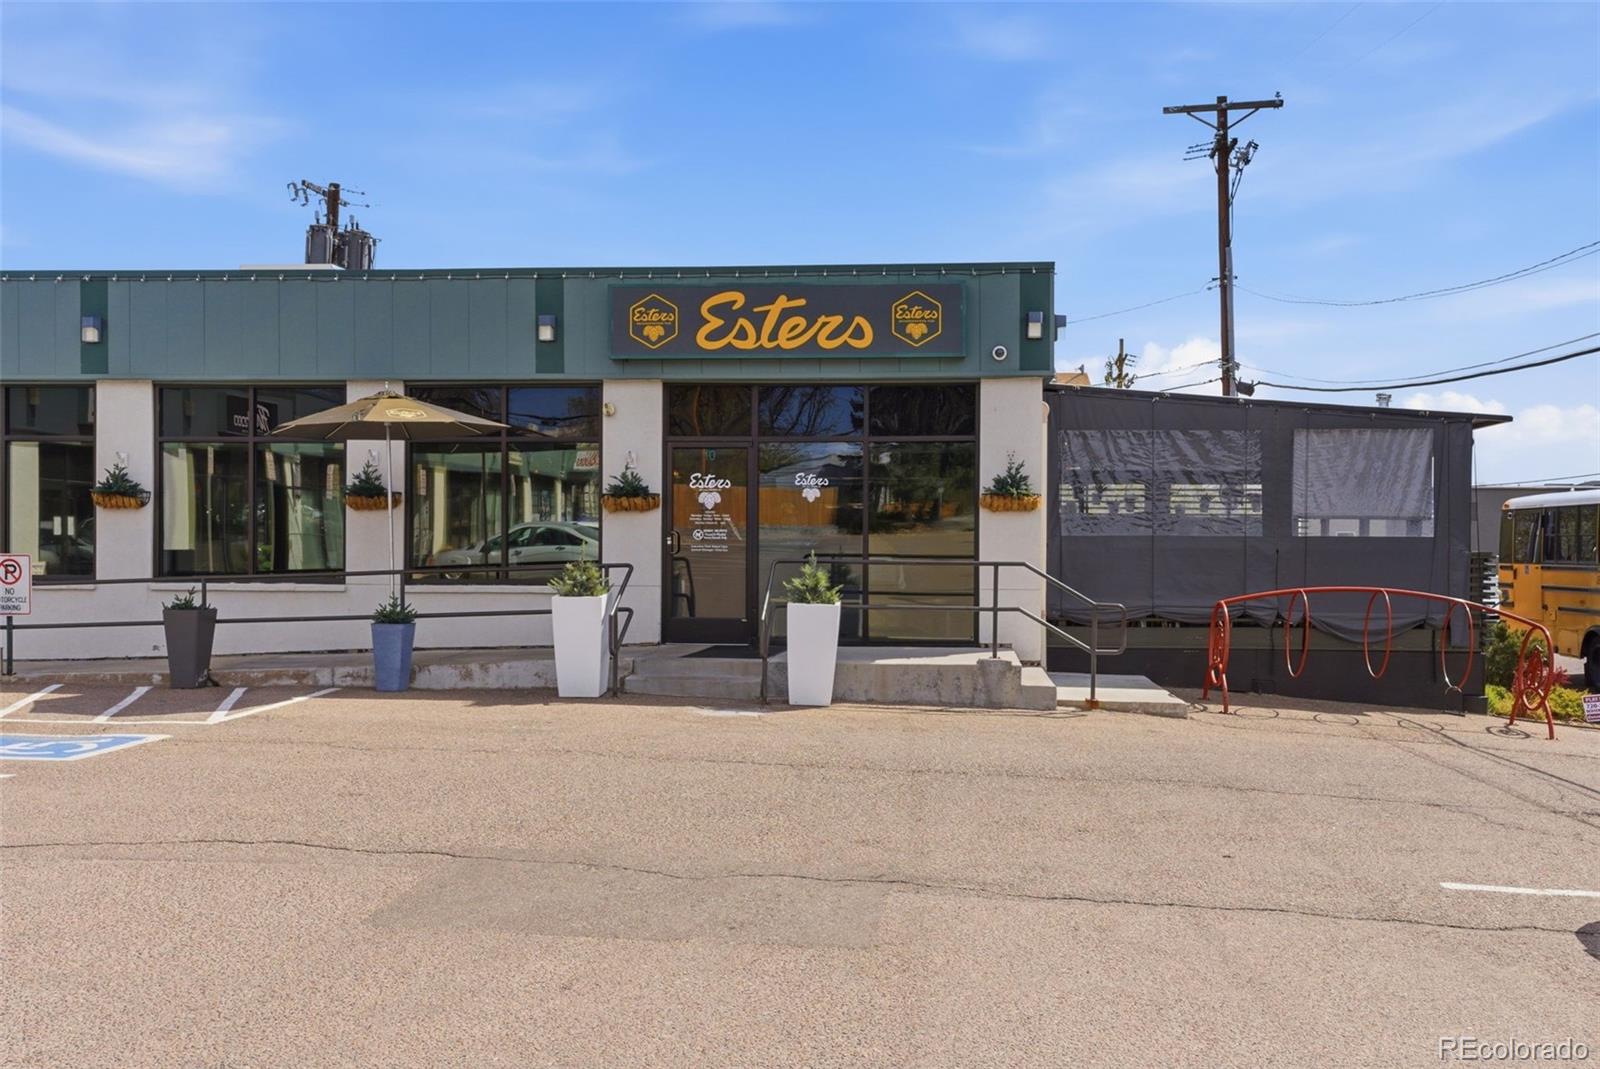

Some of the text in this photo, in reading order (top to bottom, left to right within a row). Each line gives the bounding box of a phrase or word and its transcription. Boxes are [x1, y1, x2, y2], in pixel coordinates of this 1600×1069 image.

[633, 307, 675, 321] Esters
[896, 304, 938, 319] Esters
[696, 291, 873, 351] Esters
[689, 473, 731, 488] Esters
[795, 473, 829, 486] Esters
